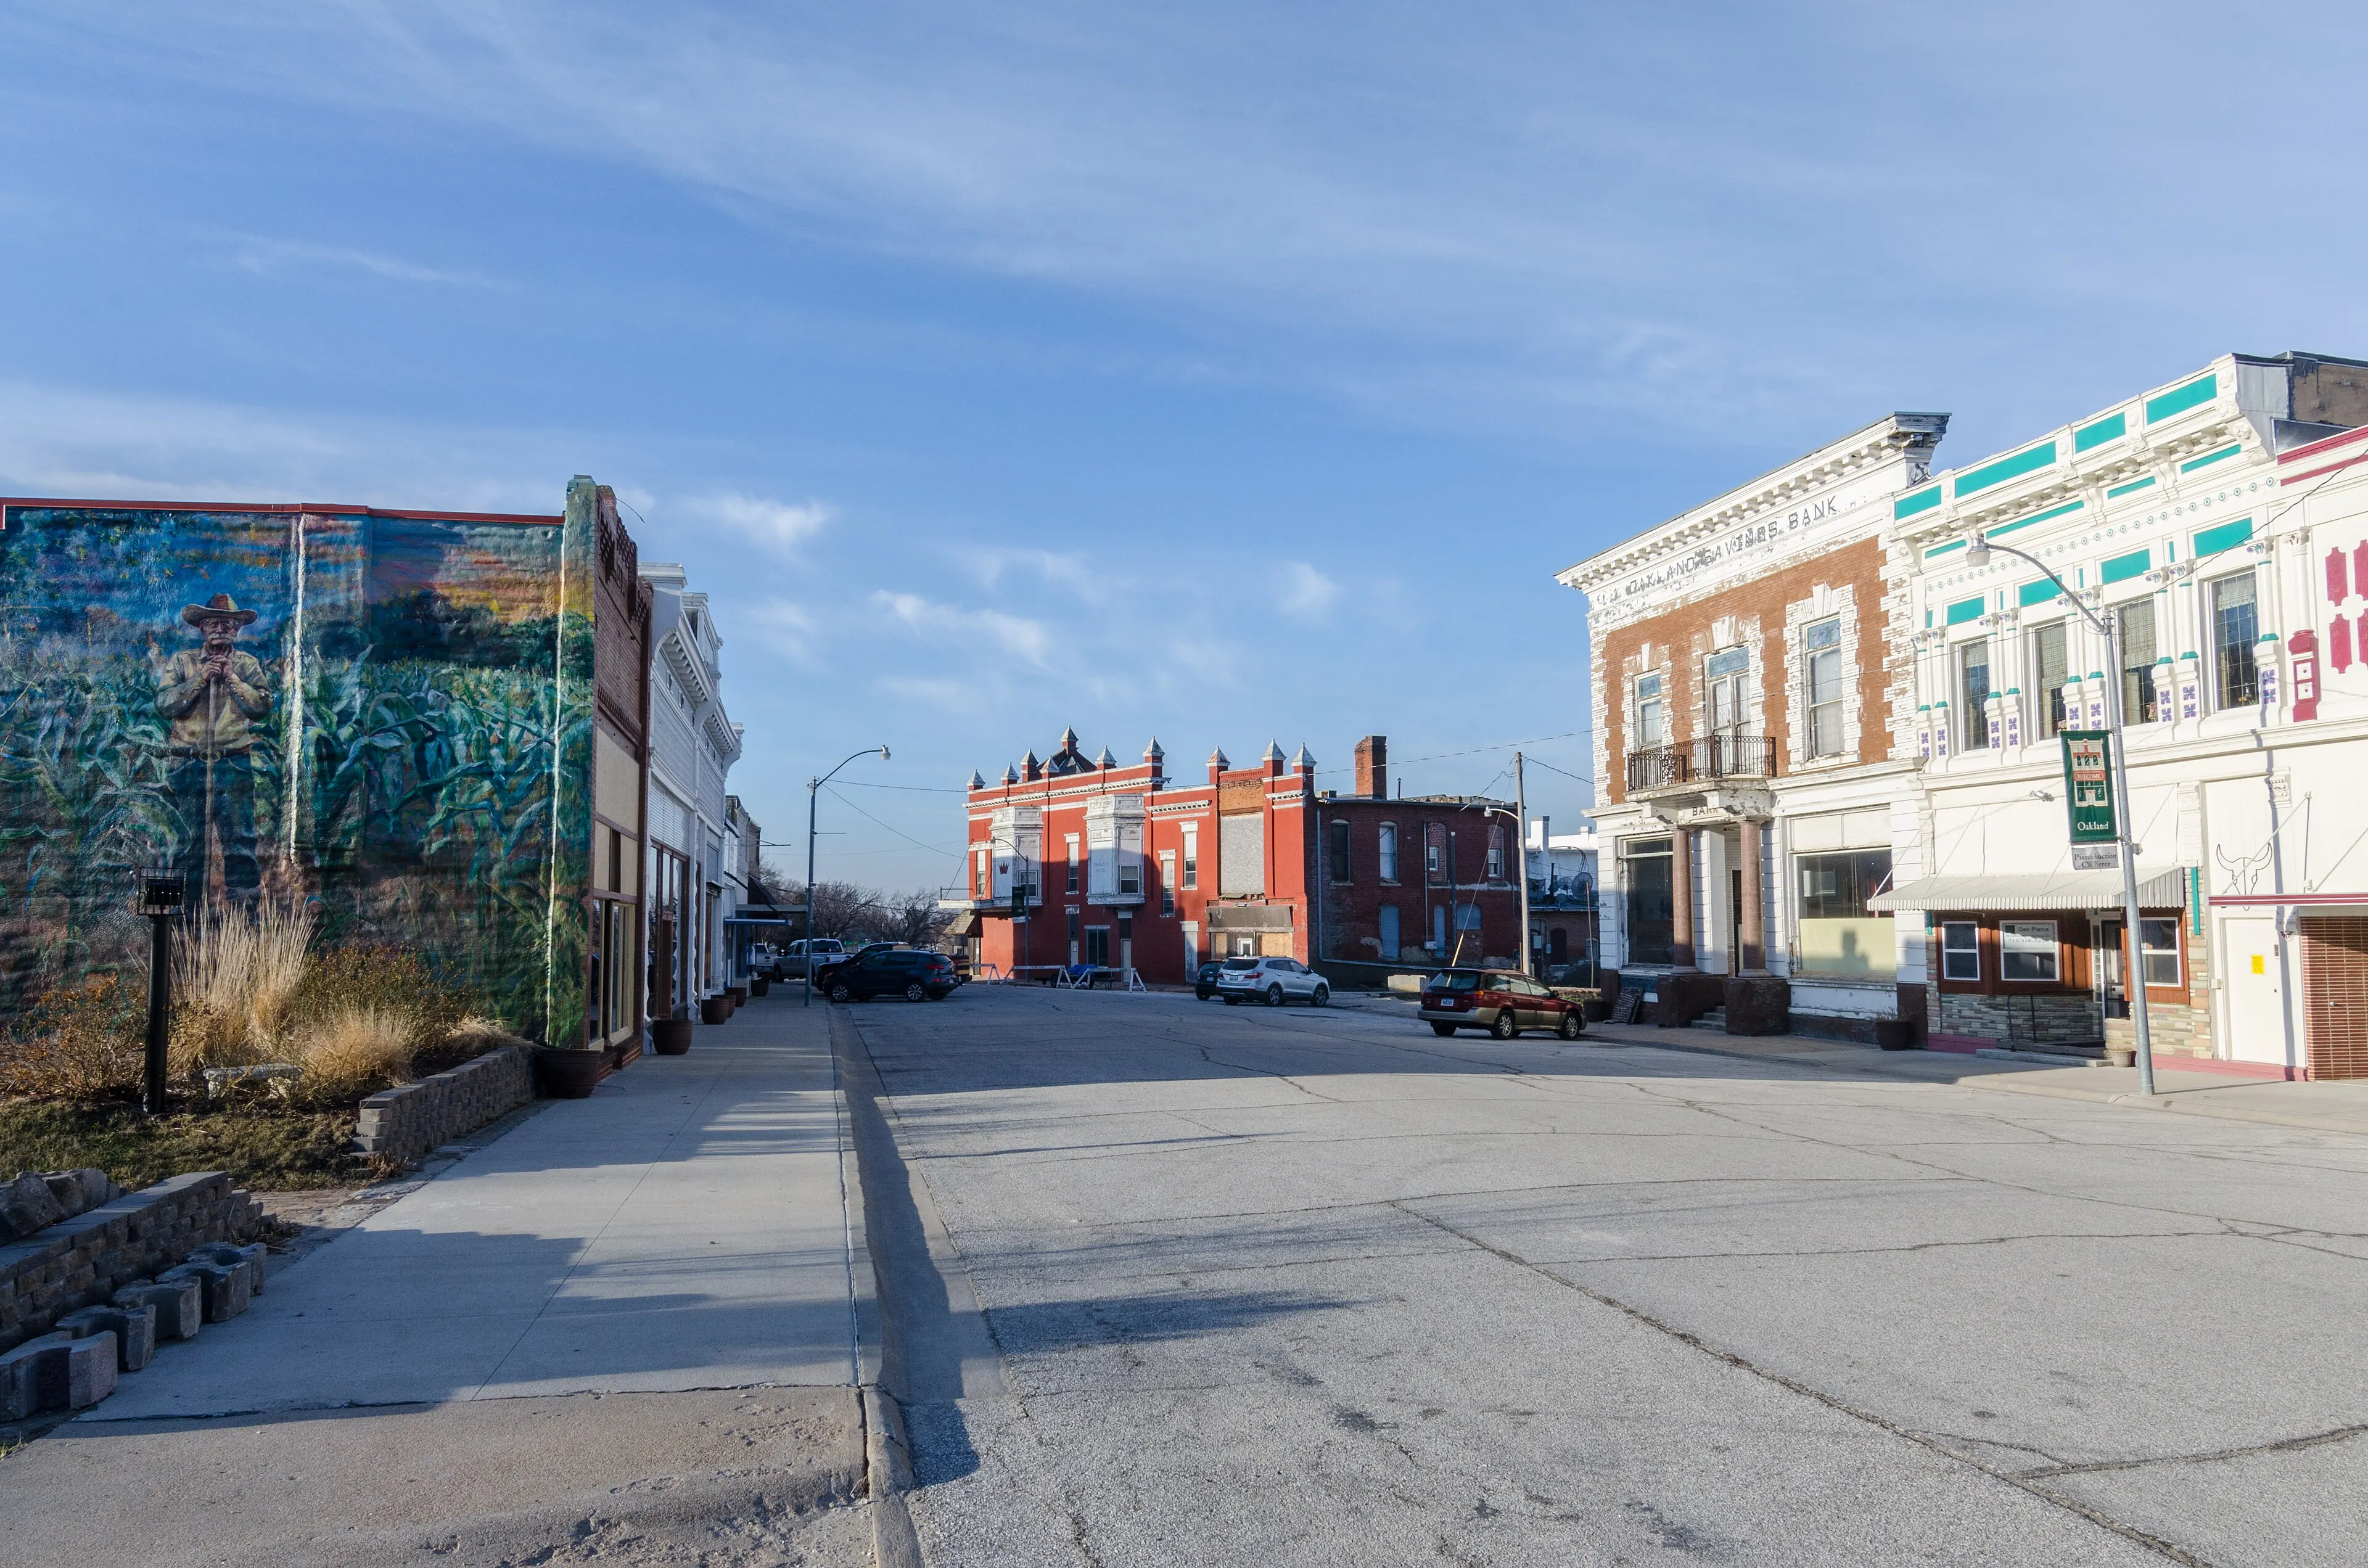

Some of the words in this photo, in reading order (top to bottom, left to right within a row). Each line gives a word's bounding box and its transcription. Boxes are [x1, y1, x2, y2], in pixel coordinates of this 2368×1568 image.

[1628, 556, 1695, 594] OAKLAND
[1788, 495, 1837, 530] BANK
[2077, 821, 2109, 831] Oakland
